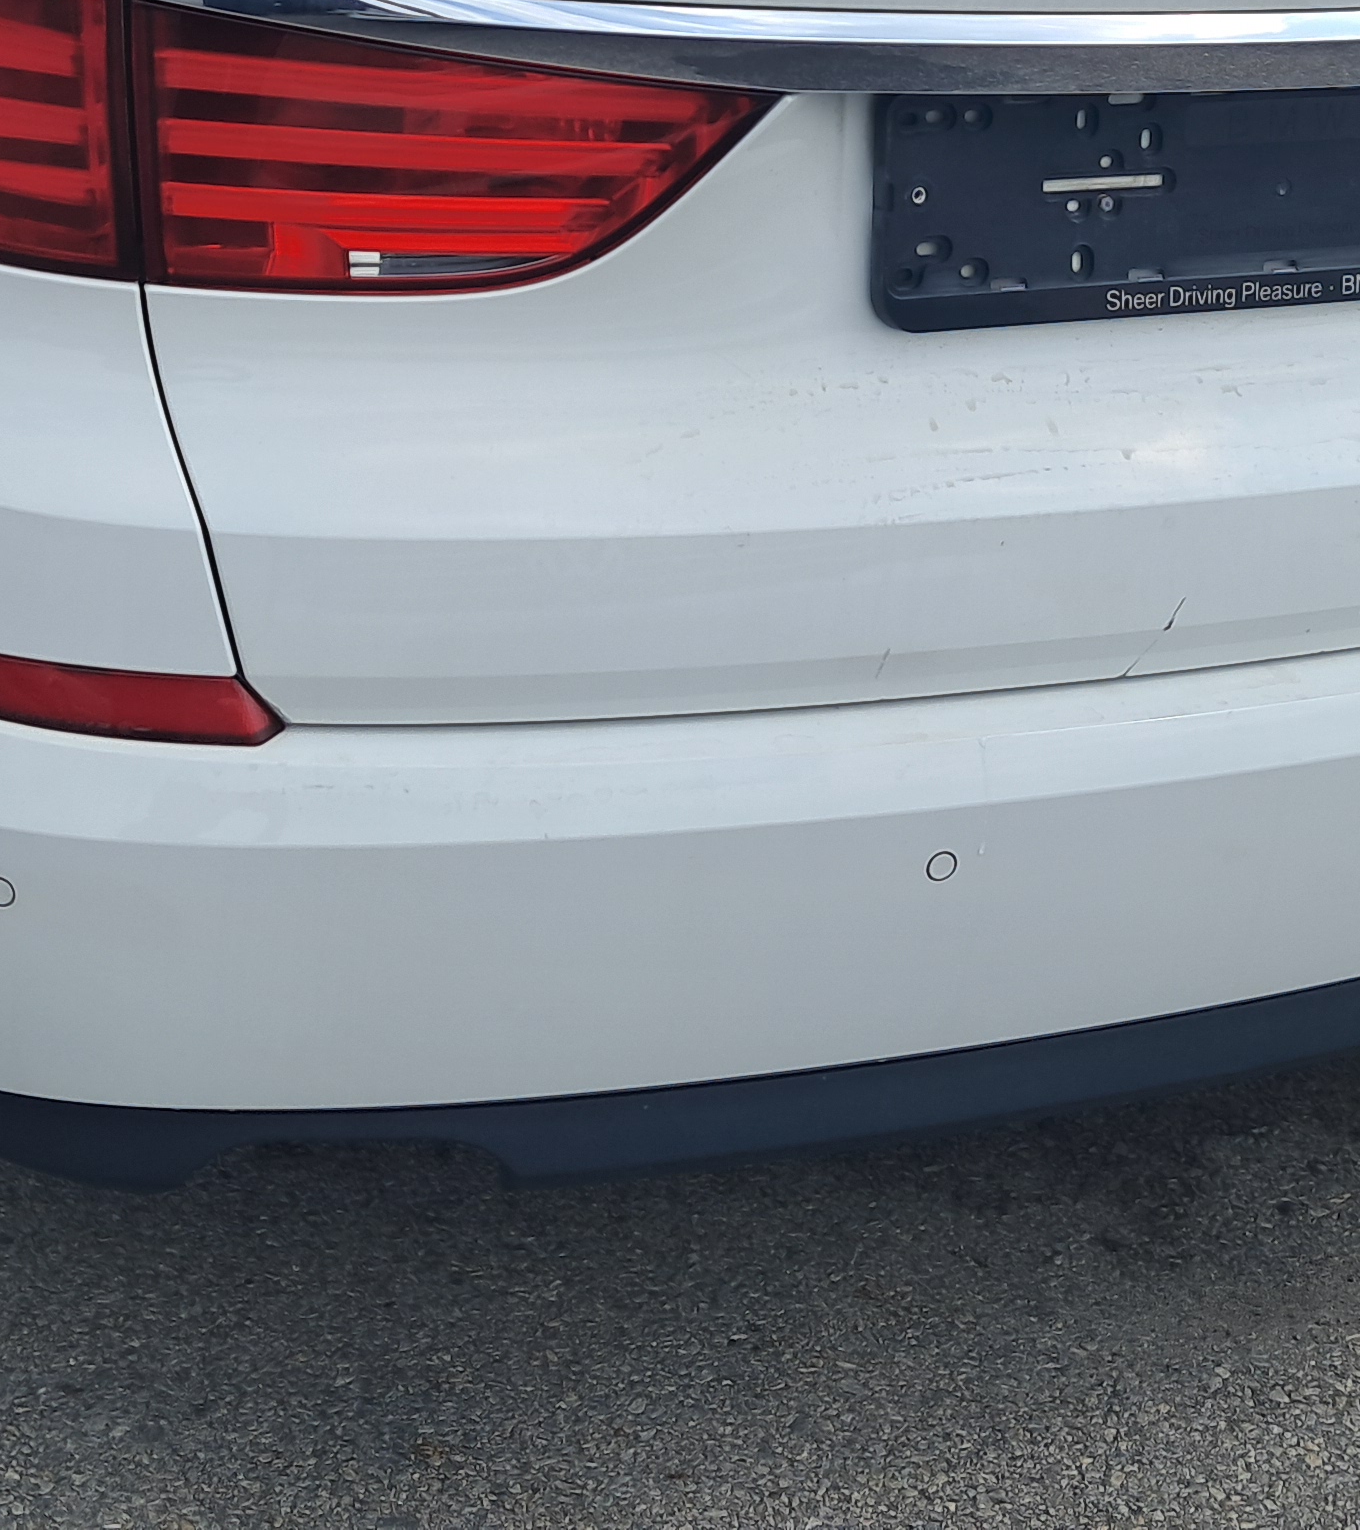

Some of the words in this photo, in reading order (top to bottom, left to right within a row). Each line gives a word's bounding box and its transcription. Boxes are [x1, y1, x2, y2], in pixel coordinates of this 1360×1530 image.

[1106, 288, 1164, 311] Sheer
[1169, 284, 1236, 308] Driving
[1242, 280, 1322, 302] Pleasure
